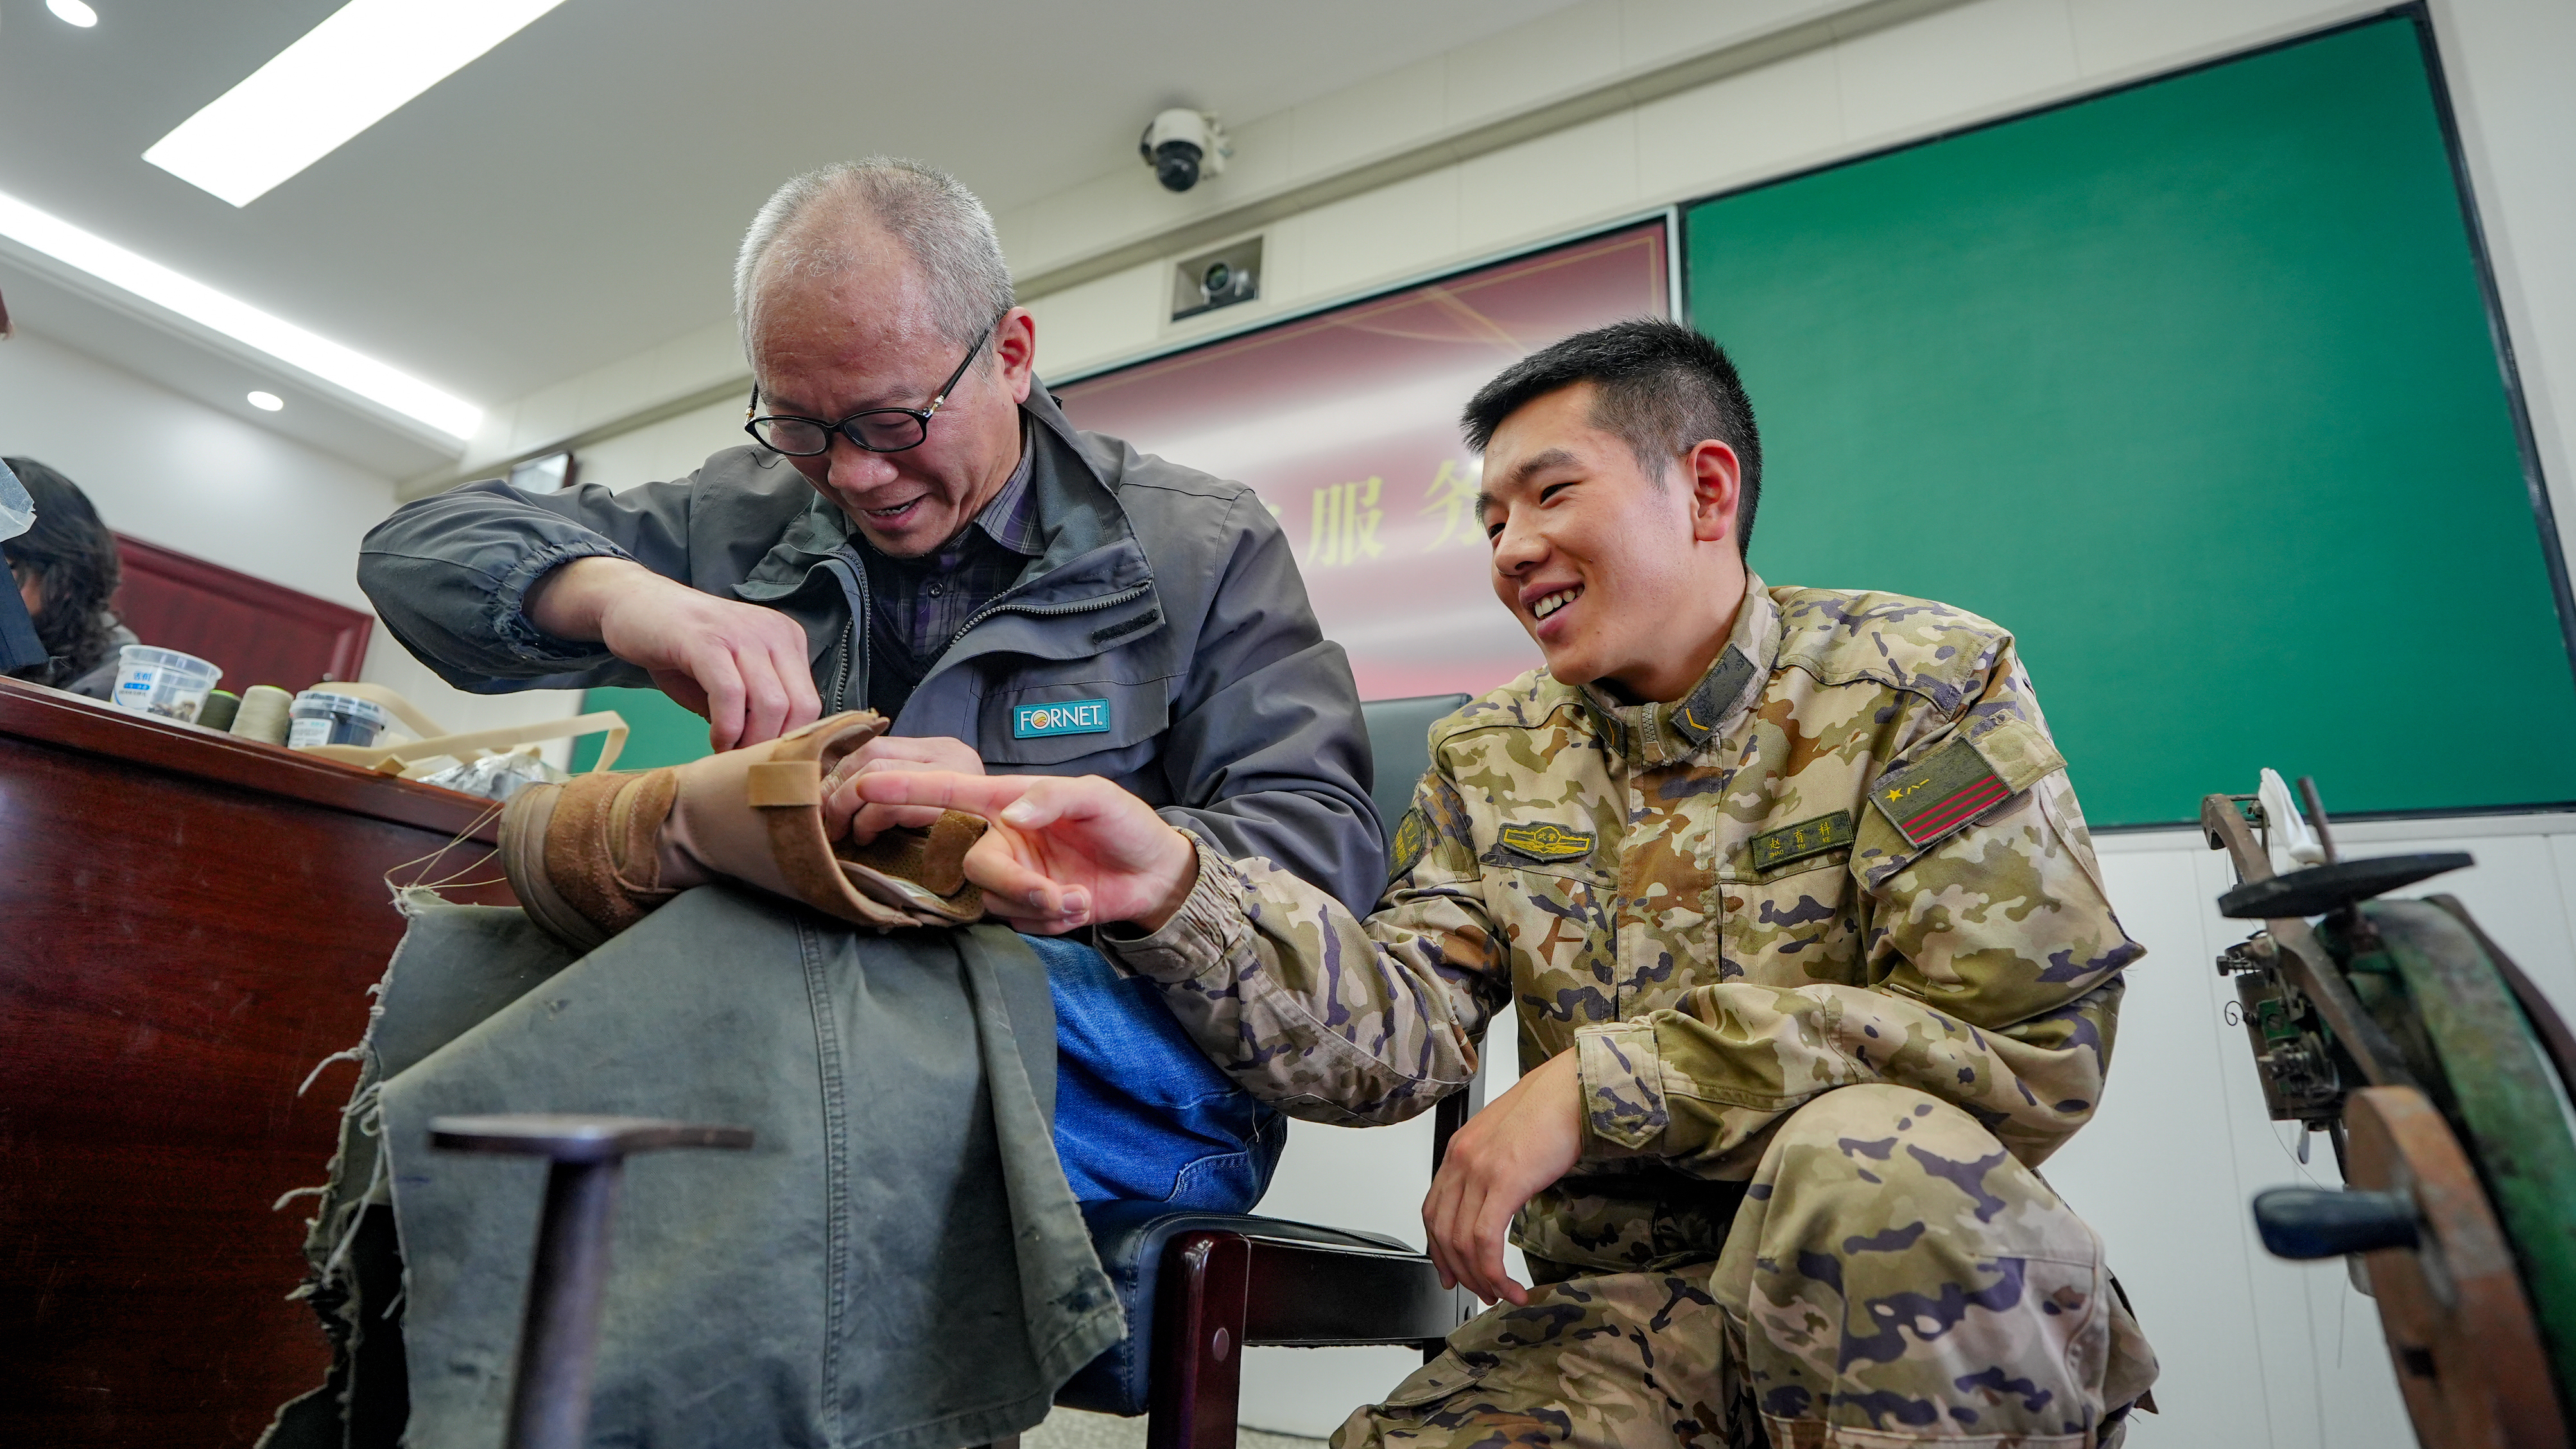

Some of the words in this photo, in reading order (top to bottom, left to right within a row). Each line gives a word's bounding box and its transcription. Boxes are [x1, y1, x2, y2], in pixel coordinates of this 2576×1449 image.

[1259, 459, 1485, 567] 服务
[1020, 706, 1102, 731] FORNET
[1537, 832, 1556, 842] 武警
[1769, 850, 1784, 858] ZHAO
